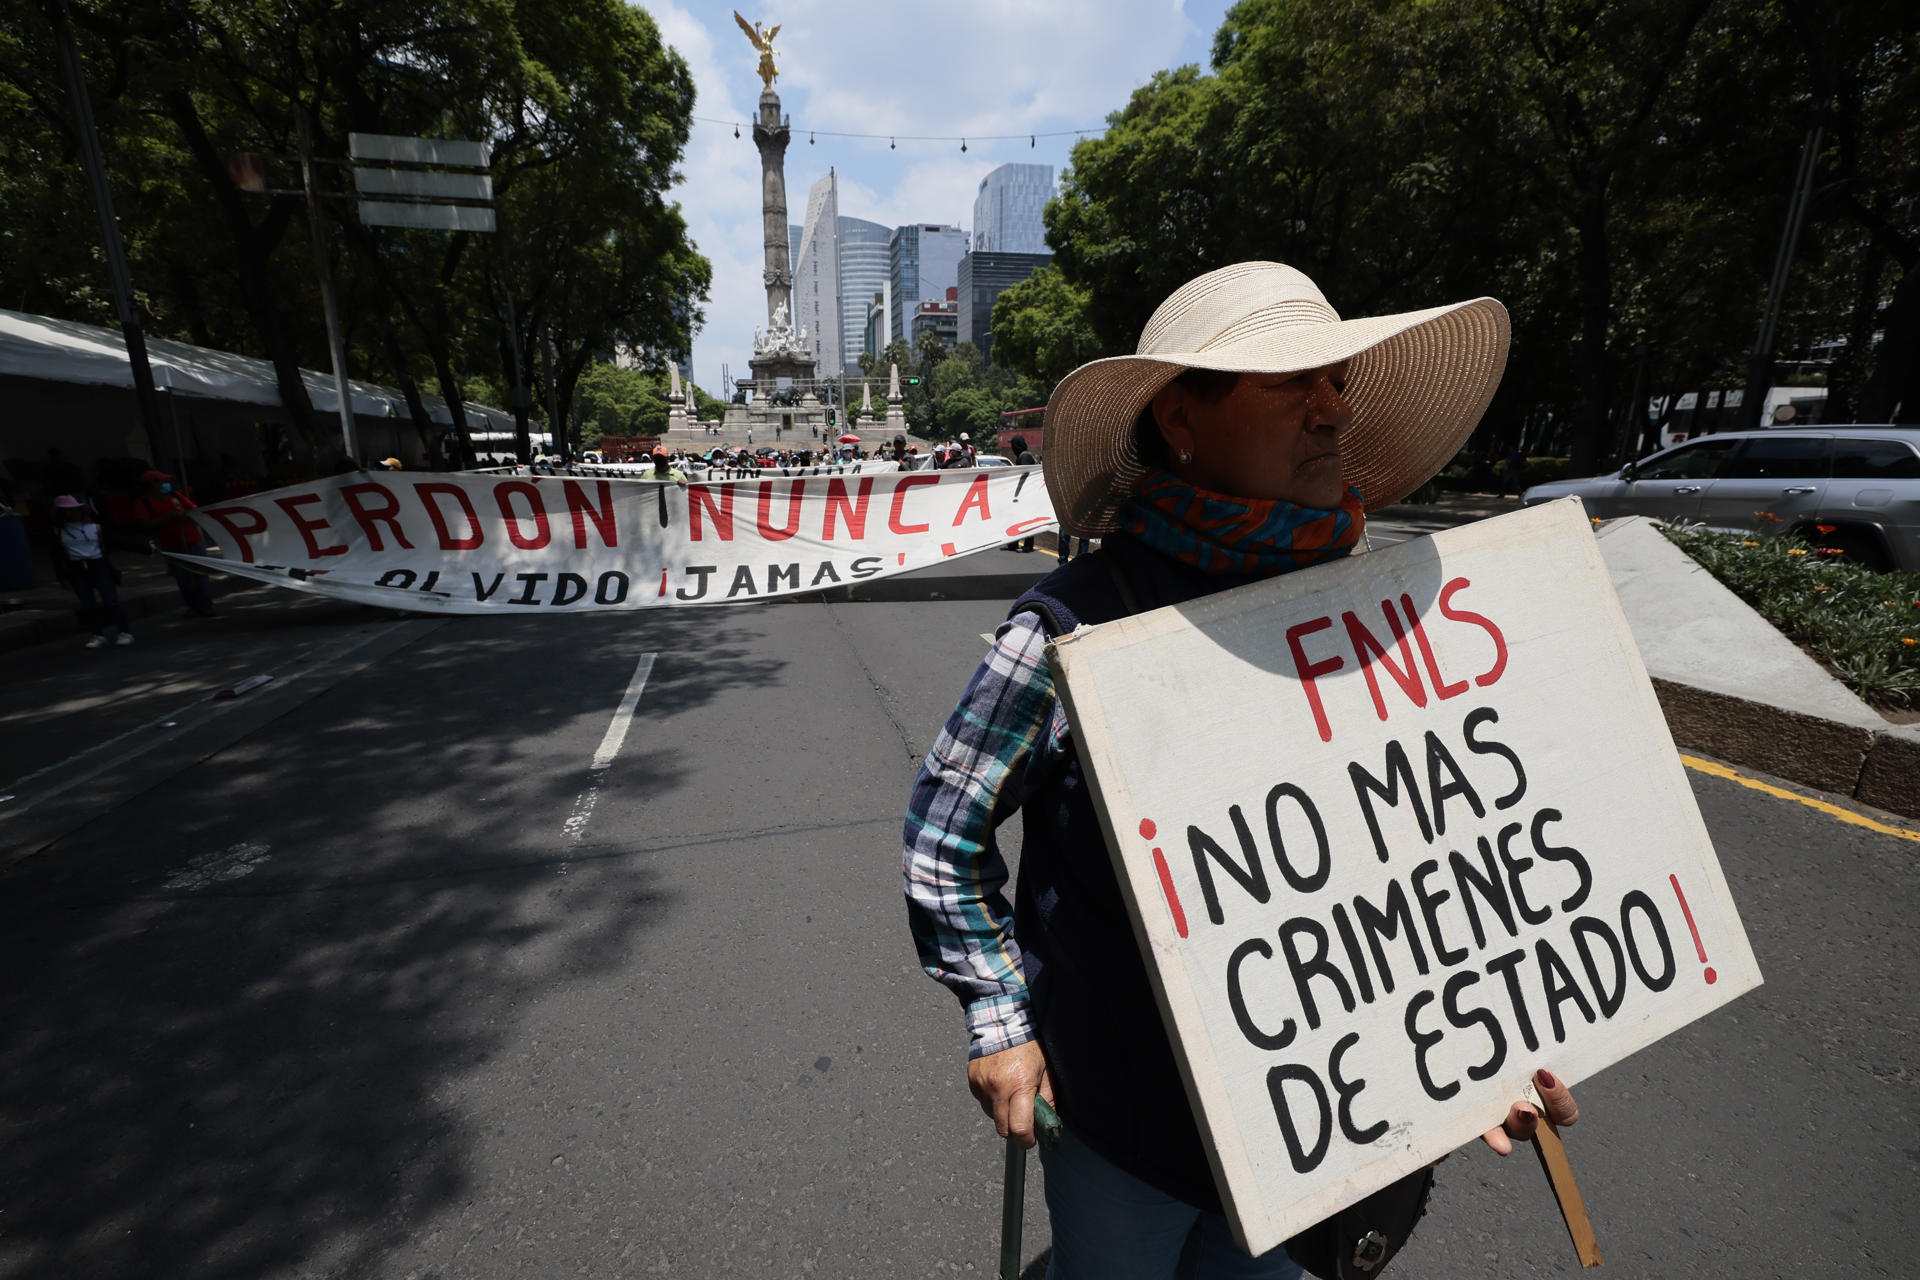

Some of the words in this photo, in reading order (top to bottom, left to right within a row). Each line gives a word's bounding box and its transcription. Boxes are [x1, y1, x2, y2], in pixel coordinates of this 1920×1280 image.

[1286, 577, 1508, 742] FNLS
[1139, 782, 1332, 938] ¡NO
[1348, 707, 1528, 863] MAS
[1227, 808, 1593, 1051] CRIMENES
[1266, 1032, 1389, 1174] DE
[1404, 874, 1717, 1101] ESTADO!
